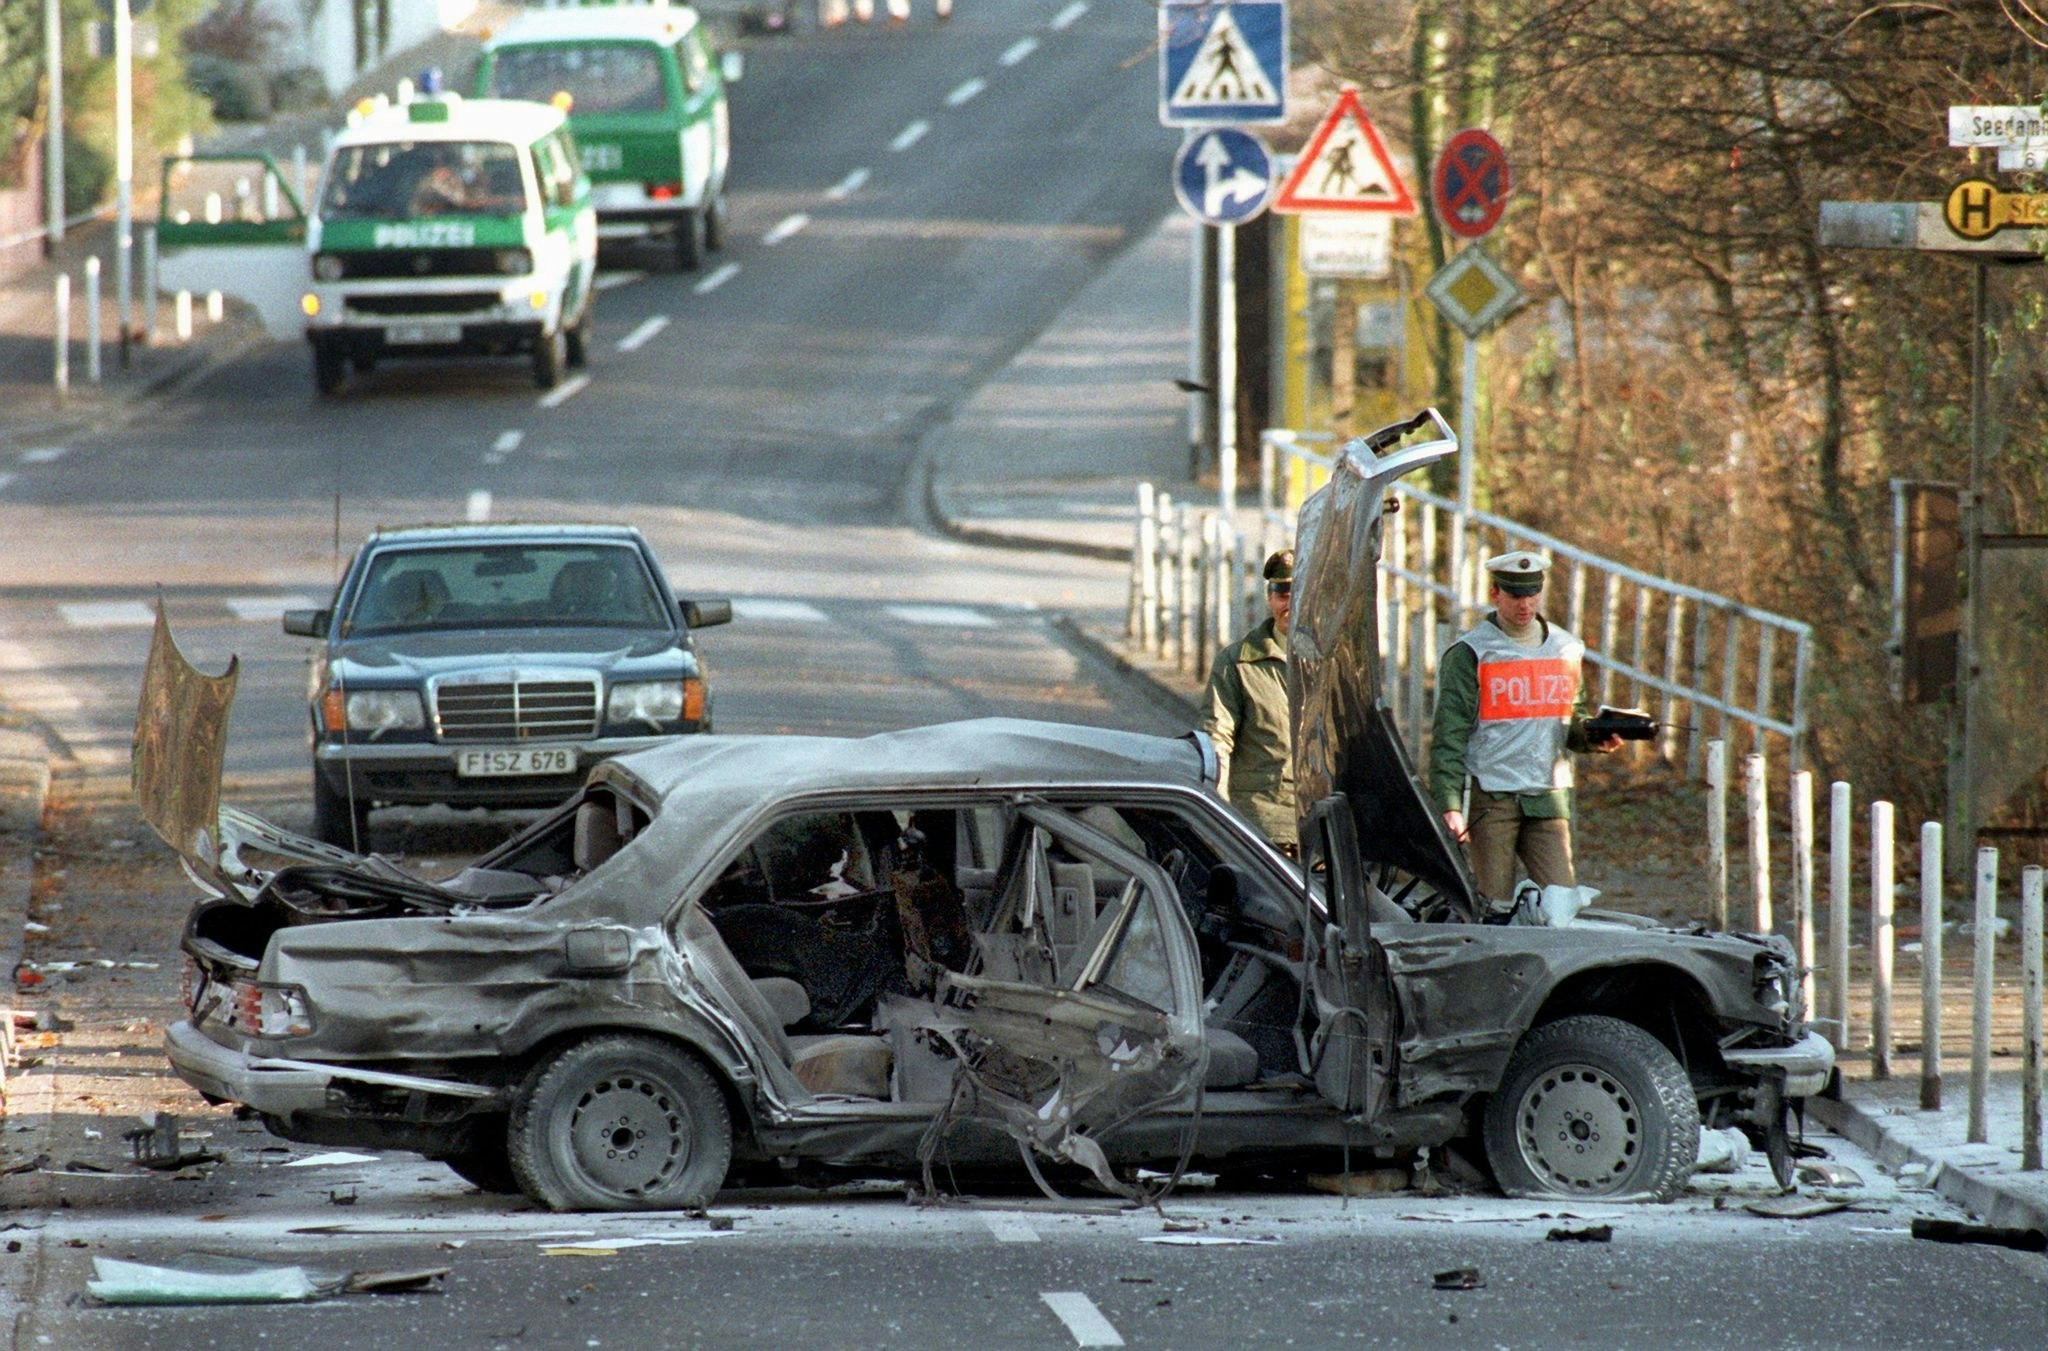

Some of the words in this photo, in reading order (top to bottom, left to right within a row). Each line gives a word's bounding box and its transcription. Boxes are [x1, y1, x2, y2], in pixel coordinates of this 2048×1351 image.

[1961, 188, 1991, 228] H
[466, 753, 479, 773] F
[493, 752, 521, 772] SZ
[531, 751, 566, 770] 678
